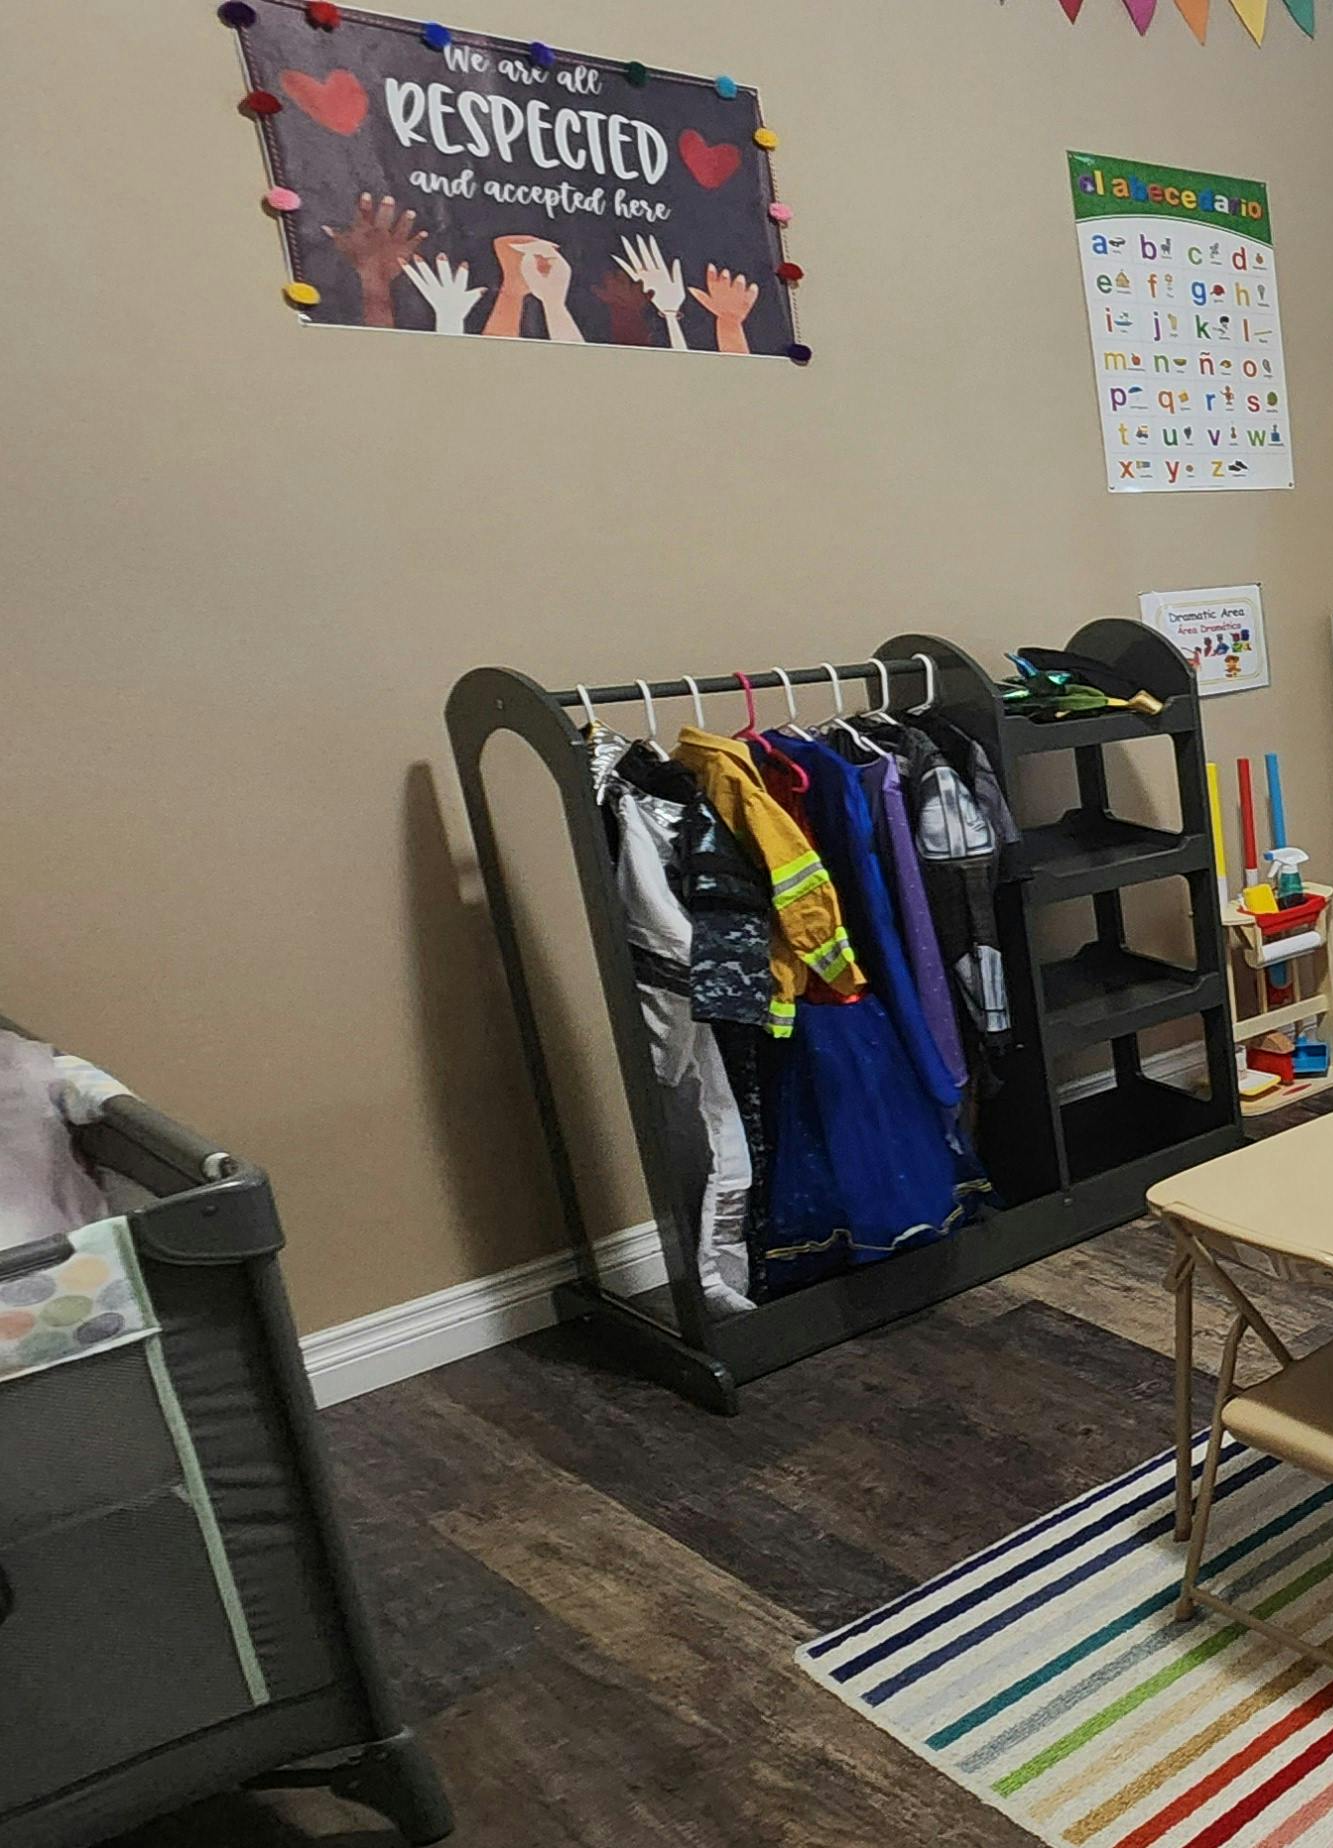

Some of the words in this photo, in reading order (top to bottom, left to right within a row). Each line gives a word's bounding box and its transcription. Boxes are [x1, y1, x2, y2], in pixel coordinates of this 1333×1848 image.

[443, 45, 490, 75] We
[498, 60, 549, 84] are
[556, 65, 602, 95] all
[384, 77, 669, 186] RESPECTED
[409, 168, 476, 200] and
[483, 178, 607, 219] accepted
[614, 186, 672, 223] here
[1092, 235, 1108, 254] a
[1140, 234, 1157, 260] b
[1188, 247, 1202, 265] c
[1232, 247, 1247, 270] d
[1096, 274, 1112, 294] e
[1148, 273, 1157, 298] f
[1192, 282, 1206, 306] g
[1235, 282, 1250, 306] h
[1105, 307, 1112, 332] i
[1153, 311, 1161, 341] j
[1195, 314, 1211, 339] k
[1104, 352, 1126, 370] m
[1154, 355, 1169, 373] n
[1199, 352, 1214, 375] ñ
[1243, 360, 1257, 378] o
[1110, 388, 1127, 411] p
[1158, 391, 1174, 414] q
[1205, 394, 1216, 411] r
[1247, 395, 1260, 412] s
[1118, 423, 1129, 445] t
[1163, 429, 1178, 446] u
[1207, 429, 1220, 446] v
[1247, 430, 1266, 446] w
[1119, 461, 1135, 478] x
[1165, 461, 1180, 483] y
[1211, 461, 1225, 477] z
[1168, 610, 1216, 623] Dramatic
[1221, 608, 1245, 618] Area
